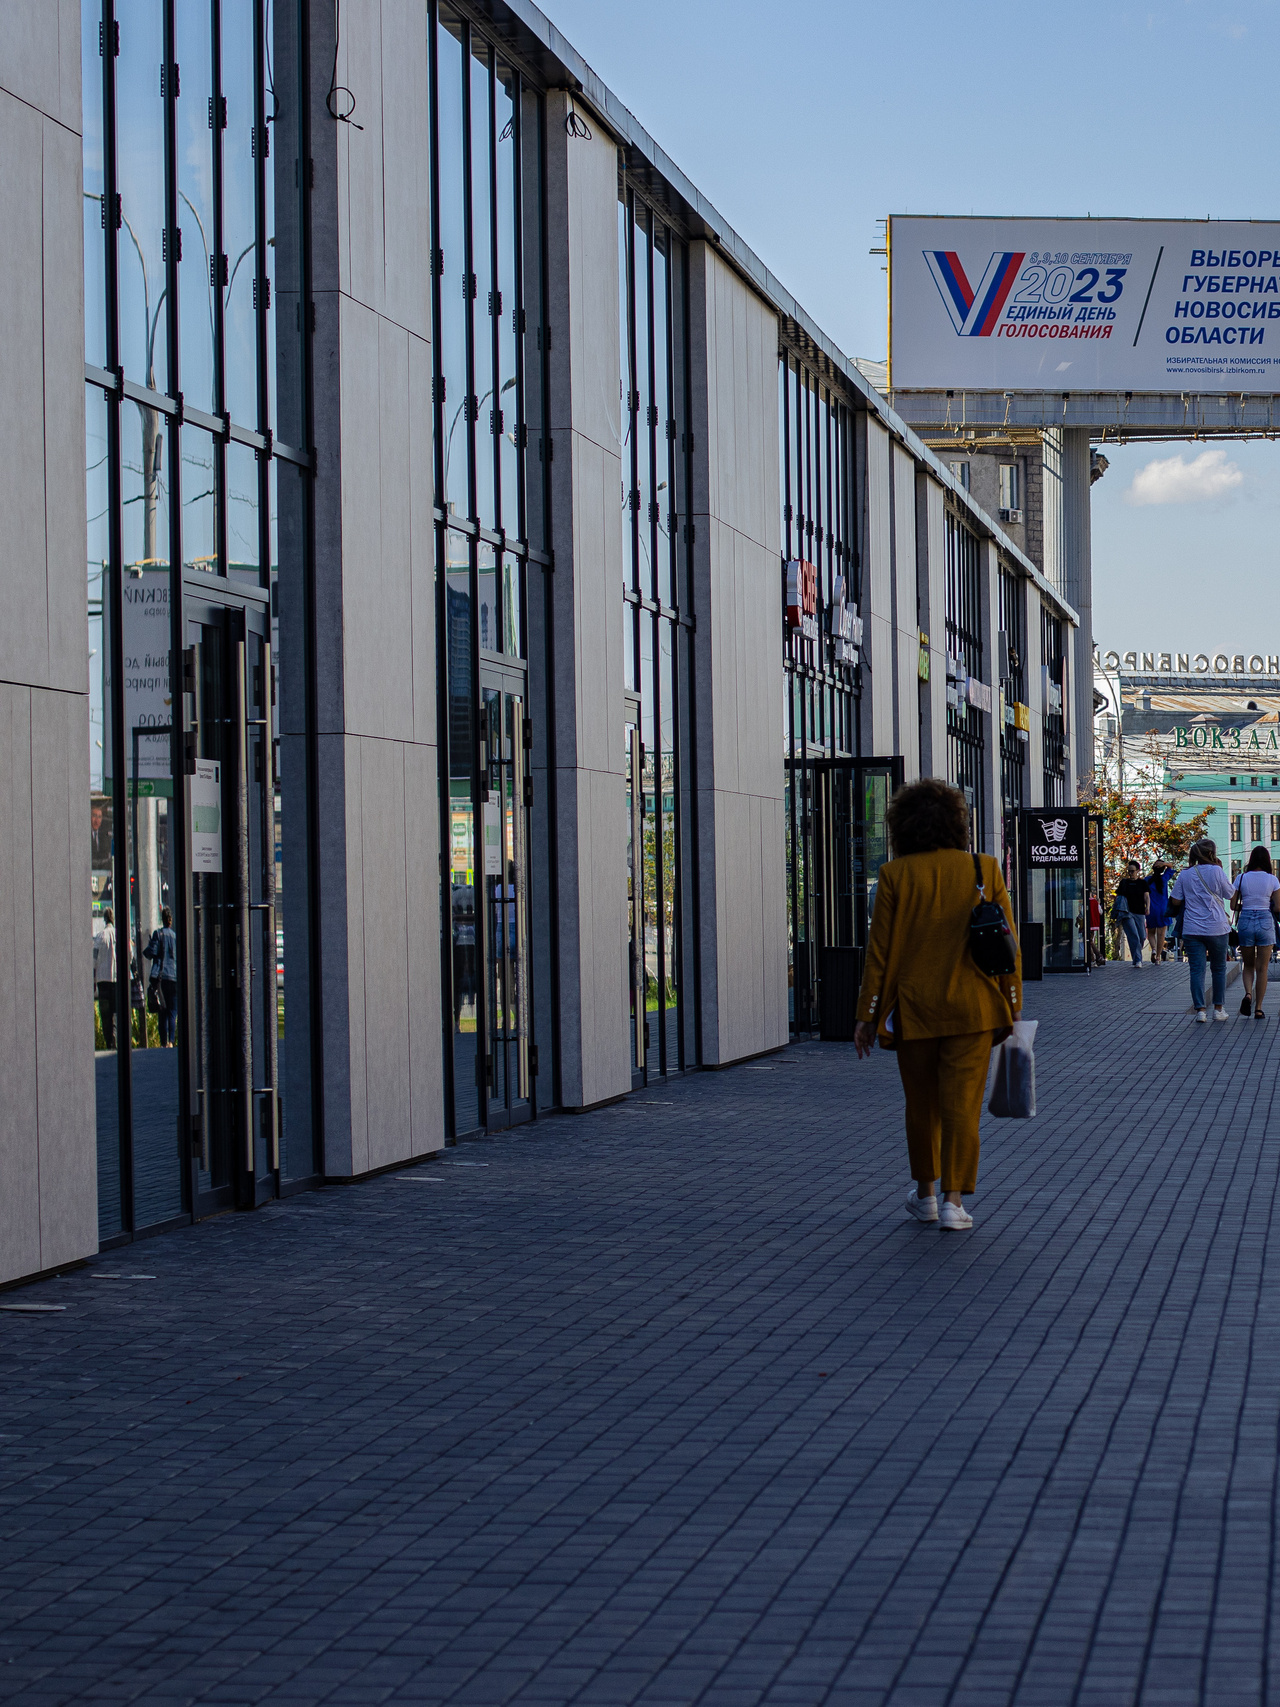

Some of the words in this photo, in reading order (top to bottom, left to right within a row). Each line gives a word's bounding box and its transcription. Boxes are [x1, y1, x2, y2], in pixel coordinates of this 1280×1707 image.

[1029, 252, 1069, 265] 8,9,10
[1070, 253, 1132, 265] СЕНТЯБРЯ
[1013, 265, 1127, 304] 2023
[1006, 303, 1074, 321] ЕДИНЫЙ
[1074, 306, 1117, 323] ДЕНЬ
[997, 324, 1113, 339] ГОЛОСОВАНИЯ
[1165, 326, 1265, 344] ОБЛАСТИ
[1230, 357, 1271, 365] КОМИССИЯ
[1166, 366, 1265, 374] www.novosibirsk.izbirkom.ru
[1174, 726, 1279, 749] ВОКЗАЛ
[1031, 845, 1067, 855] КОФЕ
[1069, 845, 1078, 855] &
